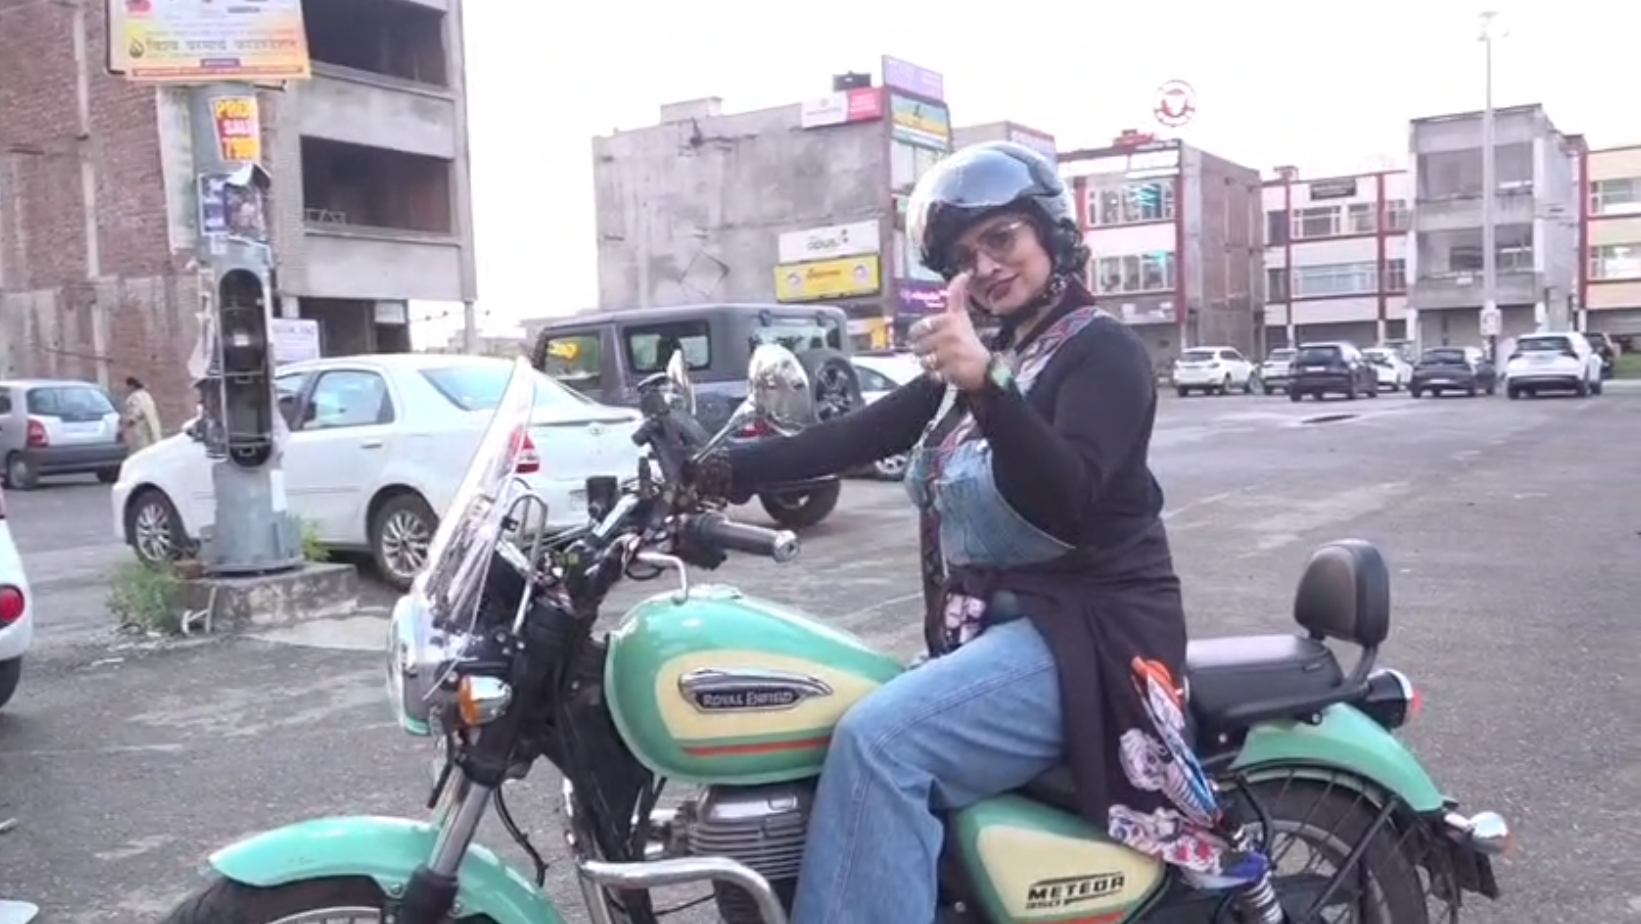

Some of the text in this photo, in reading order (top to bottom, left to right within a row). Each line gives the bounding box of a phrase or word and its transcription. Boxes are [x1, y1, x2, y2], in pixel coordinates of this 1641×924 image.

[703, 691, 793, 707] ROYAL ENFIELD
[1028, 875, 1125, 901] METEOR
